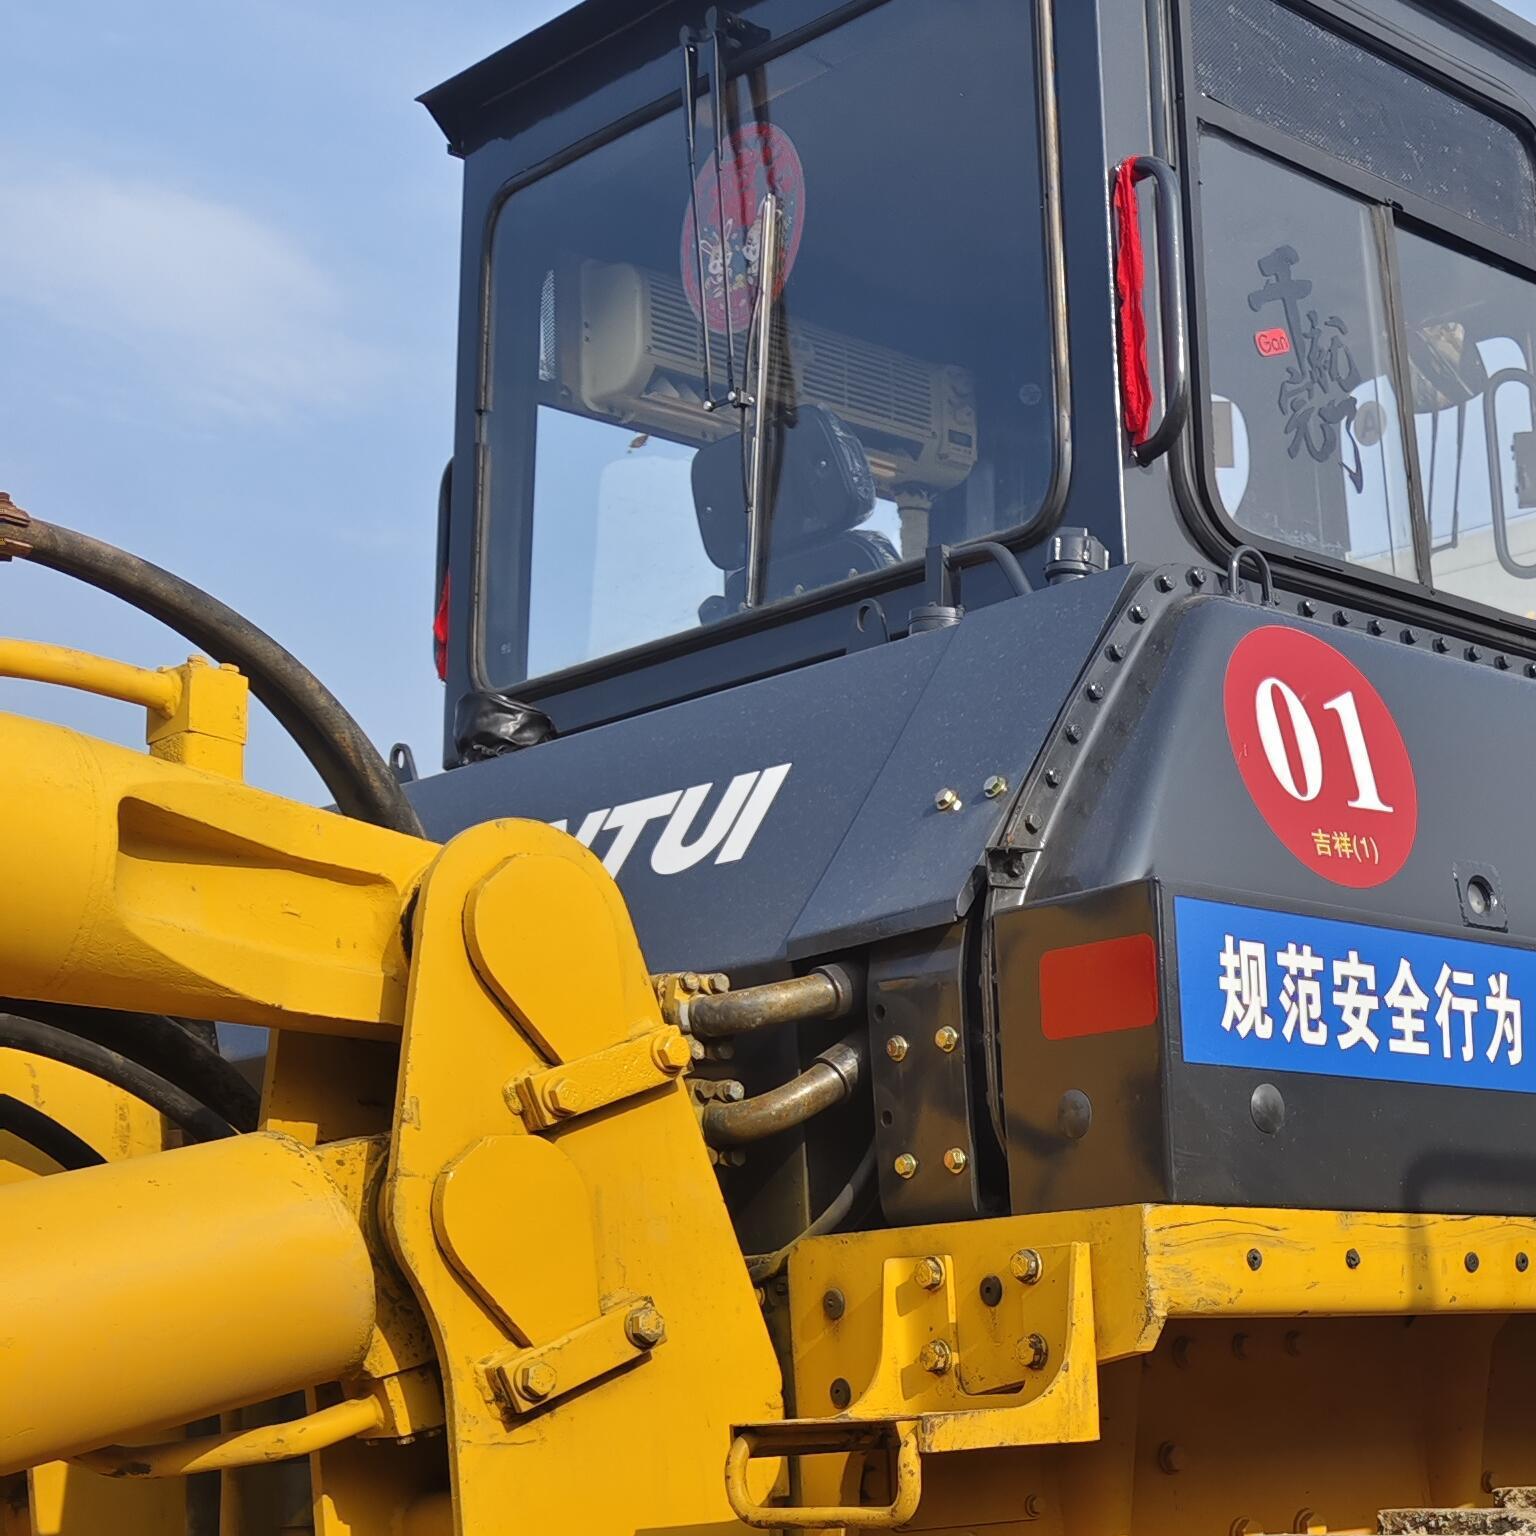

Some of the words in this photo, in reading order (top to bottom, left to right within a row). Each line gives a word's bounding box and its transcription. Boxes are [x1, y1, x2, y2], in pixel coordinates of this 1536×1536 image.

[1257, 333, 1290, 354] Gan
[1255, 677, 1394, 813] 01
[1311, 828, 1379, 865] 吉祥(1)
[1218, 934, 1523, 1066] 规范安全行为
